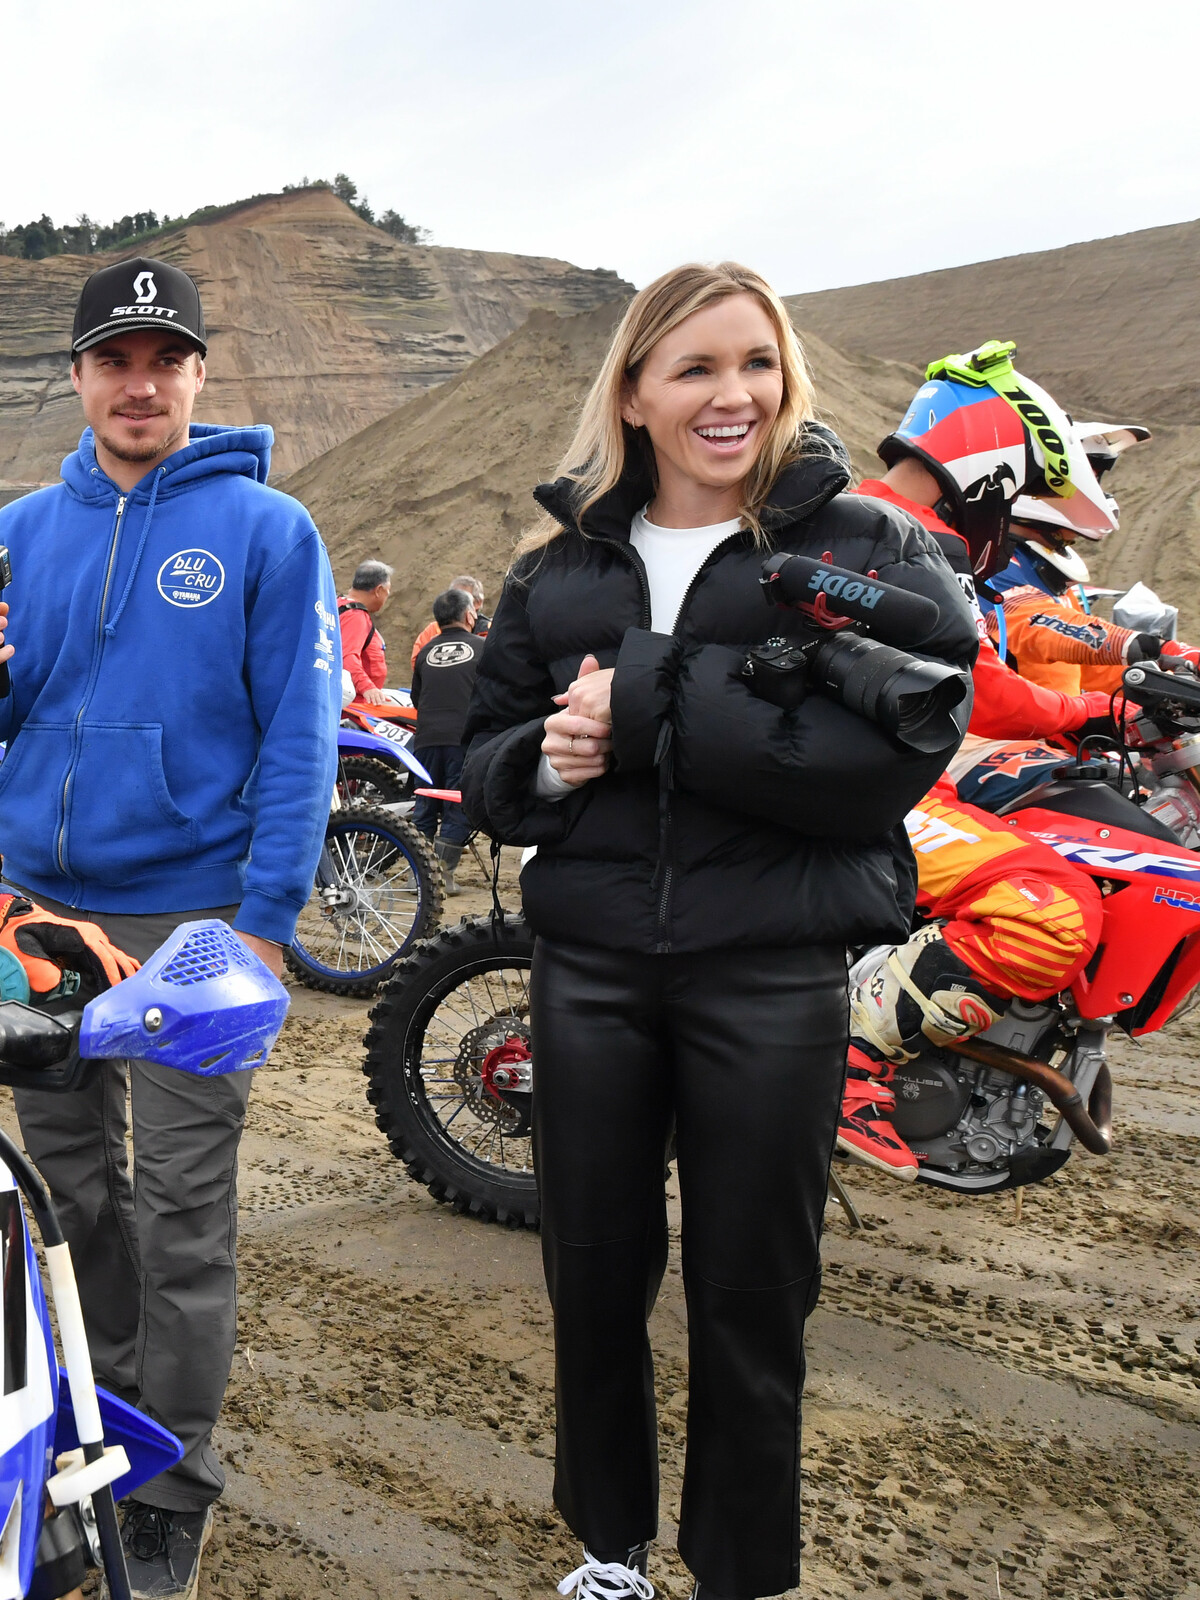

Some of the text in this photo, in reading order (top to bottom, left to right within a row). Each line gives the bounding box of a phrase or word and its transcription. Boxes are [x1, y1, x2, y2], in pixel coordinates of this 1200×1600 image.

[109, 305, 178, 318] SCOTT
[1002, 385, 1072, 488] 100%
[173, 556, 206, 571] bLU
[185, 573, 217, 588] cRU
[807, 569, 886, 610] RØDE
[801, 638, 820, 651] SONY
[378, 720, 409, 743] 503
[1018, 887, 1040, 902] LEATT
[951, 983, 967, 991] TECH
